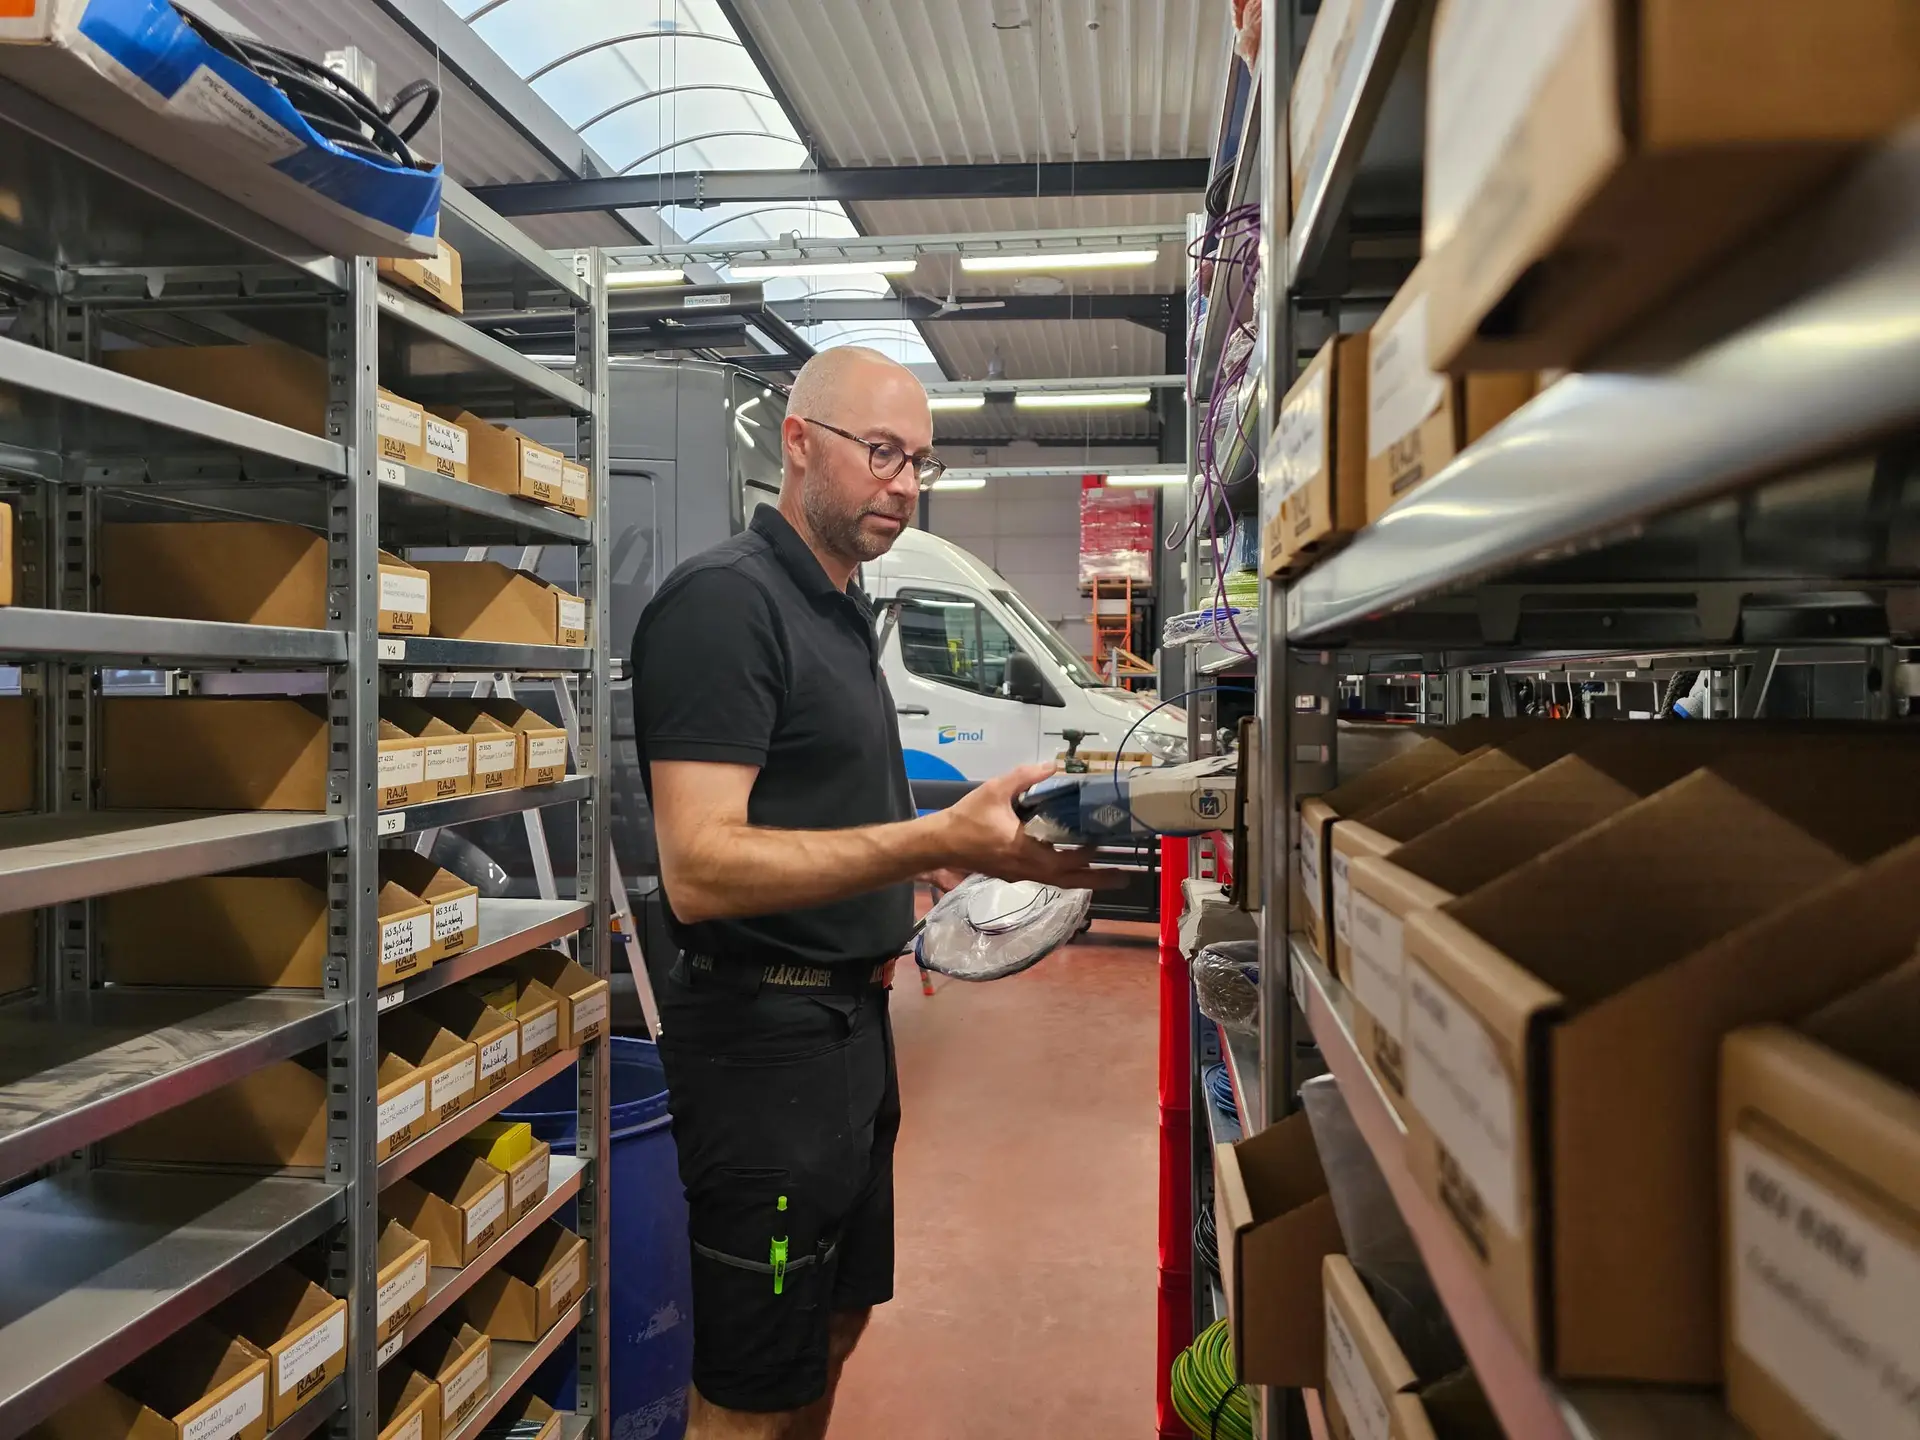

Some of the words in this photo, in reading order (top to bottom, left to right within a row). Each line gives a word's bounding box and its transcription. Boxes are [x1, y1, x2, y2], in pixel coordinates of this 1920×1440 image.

[385, 291, 395, 305] Y2
[384, 438, 406, 455] RAJA
[436, 457, 456, 473] RAJA
[387, 468, 396, 480] Y3
[533, 481, 551, 494] RAJA
[392, 612, 414, 625] RAJA
[387, 645, 396, 656] Y4
[957, 728, 984, 742] mol
[485, 772, 503, 784] RAJA
[538, 767, 554, 778] RAJA
[437, 779, 457, 791] RAJA
[386, 785, 408, 800] RAJA
[387, 819, 396, 830] Y5
[762, 964, 832, 988] LÅKLÄDER
[386, 992, 395, 1003] Y6
[440, 1096, 460, 1116] RAJA
[389, 1124, 412, 1146] RAJA
[388, 1301, 411, 1329] RAJA
[385, 1342, 394, 1357] Y8
[296, 1363, 326, 1396] RAJA
[189, 1407, 222, 1437] MOT-401
[194, 1413, 234, 1440] texionclip
[234, 1402, 247, 1417] 401
